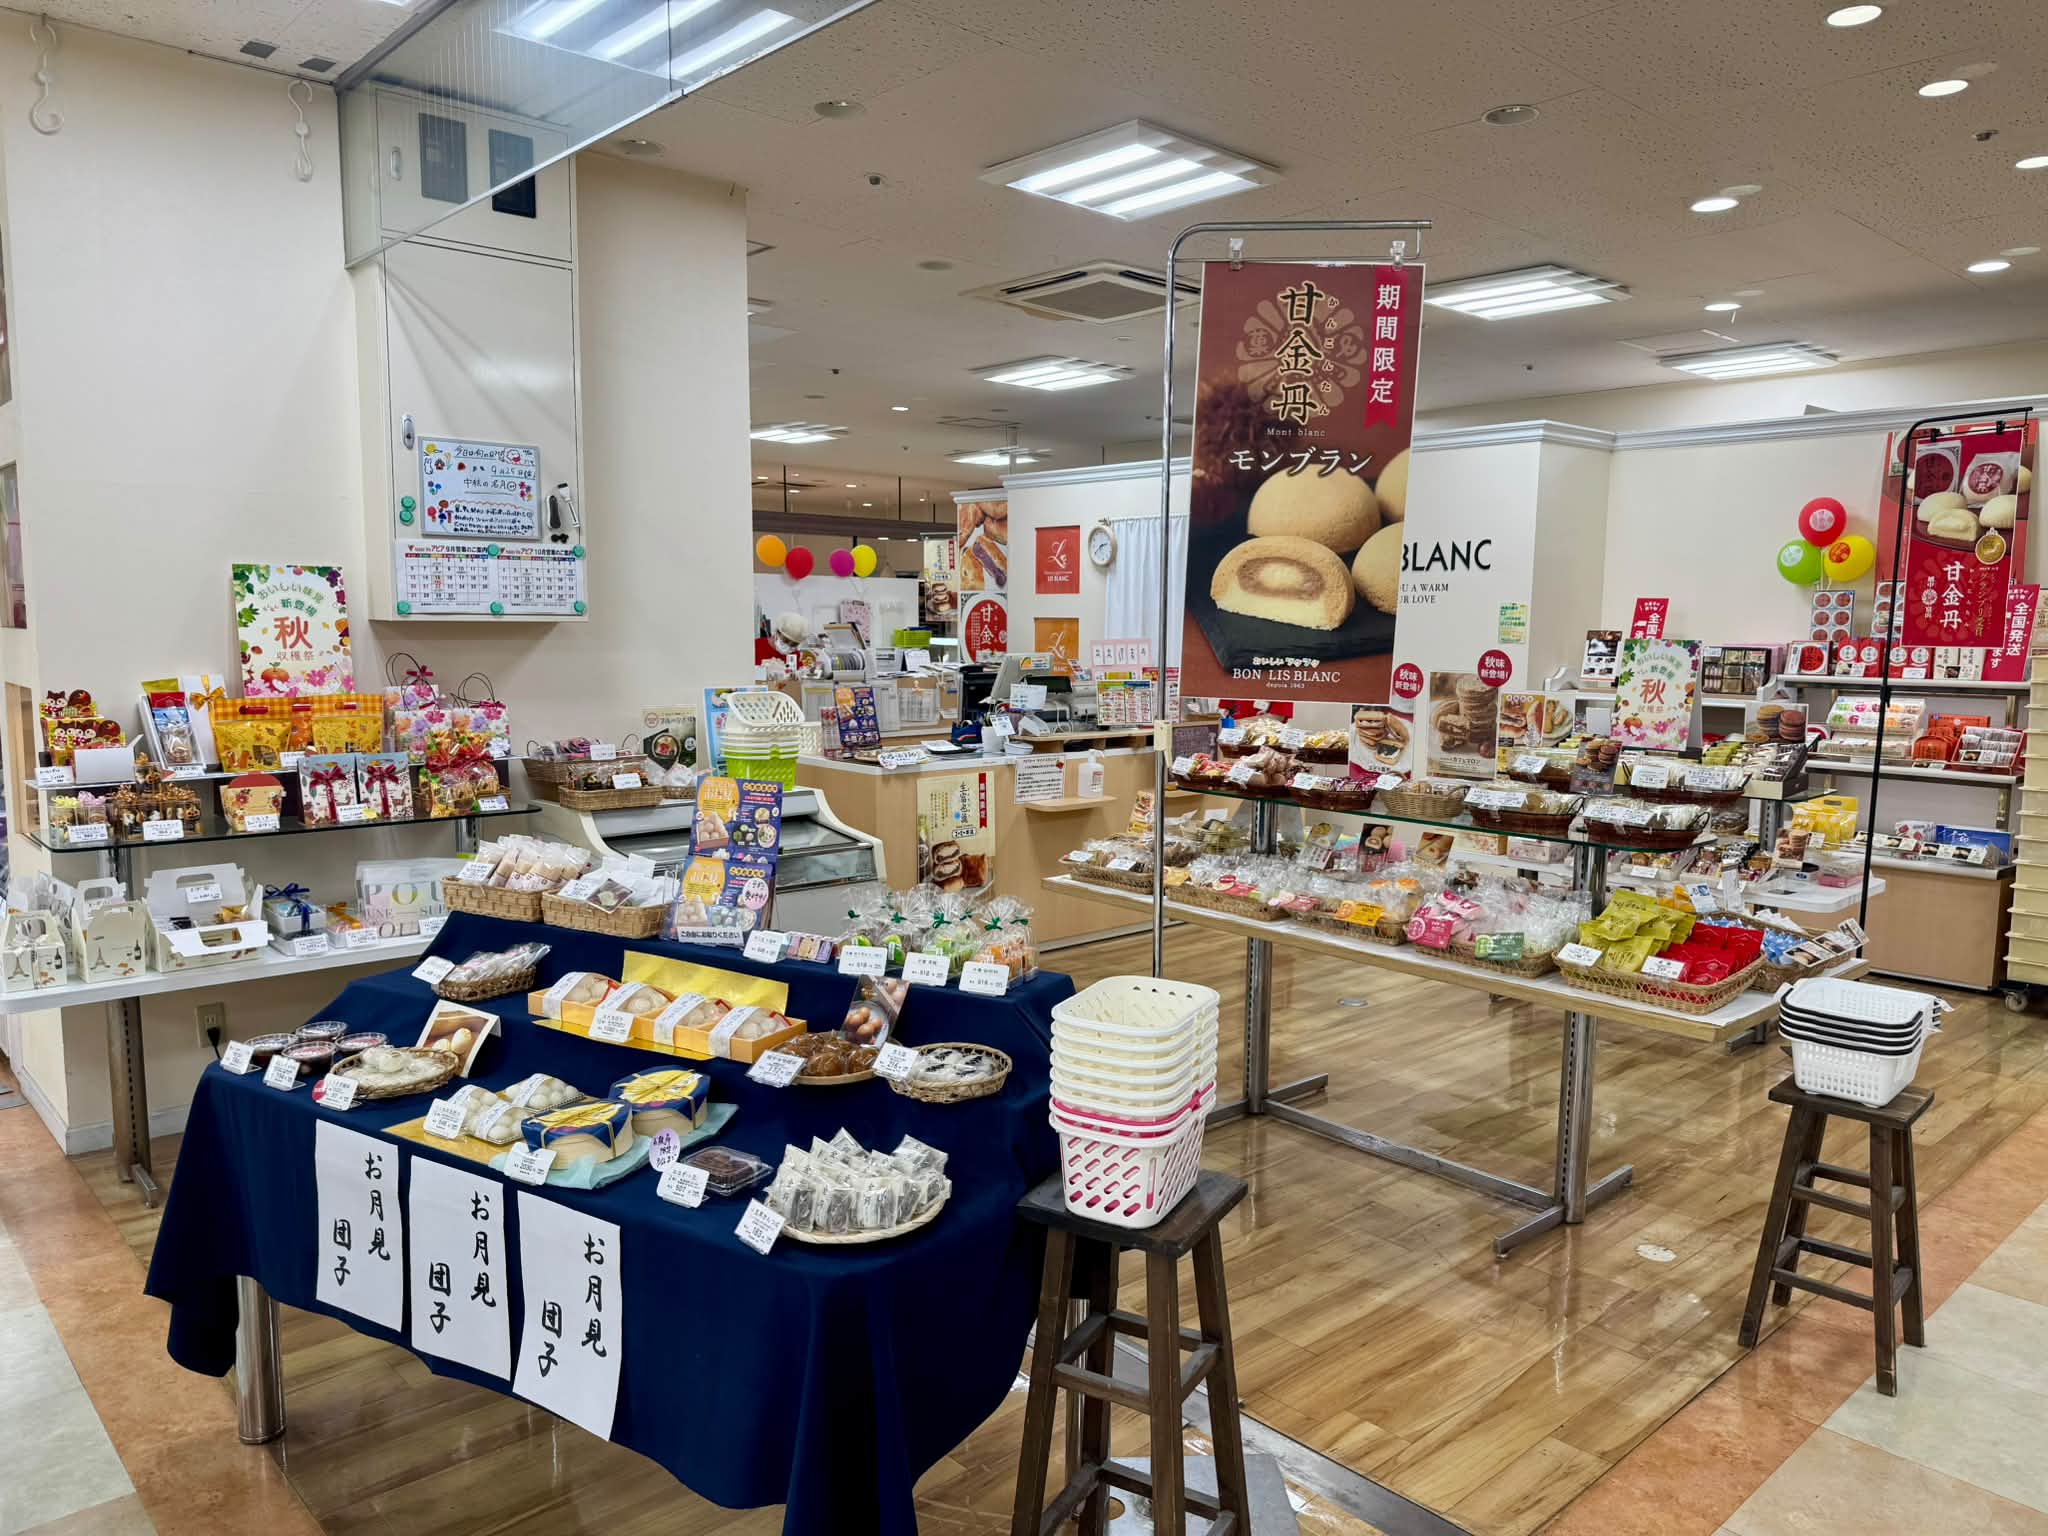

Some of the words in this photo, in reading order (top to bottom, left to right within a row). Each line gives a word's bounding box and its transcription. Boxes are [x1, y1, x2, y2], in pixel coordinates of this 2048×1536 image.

[1272, 282, 1324, 425] 甘金丹
[1370, 284, 1400, 404] 期間限定
[1267, 428, 1291, 436] Mont
[1298, 428, 1326, 437] blanc
[1229, 446, 1372, 476] モンブラン
[1411, 584, 1417, 592] A
[1420, 583, 1449, 592] WARM
[1412, 595, 1436, 604] LOVE
[1940, 561, 1965, 630] 甘金丹
[273, 616, 313, 649] 秋
[980, 603, 993, 645] 甘金
[1646, 612, 1661, 640] 全国
[2006, 602, 2030, 656] 全国発送
[1233, 668, 1261, 680] BON
[1269, 670, 1290, 681] LIS
[1294, 671, 1341, 683] BLANC
[1399, 669, 1418, 680] 秋味
[1481, 669, 1509, 680] 新登場!
[1484, 656, 1505, 669] 秋味
[1395, 681, 1420, 692] 新登場!
[1640, 679, 1666, 705] 秋
[365, 879, 443, 905] POU
[365, 1152, 391, 1261] お月見
[333, 1219, 351, 1287] 団子
[471, 1191, 496, 1308] お月見
[429, 1262, 451, 1334] 団子
[581, 1233, 607, 1357] お月見
[538, 1300, 562, 1378] 団子
